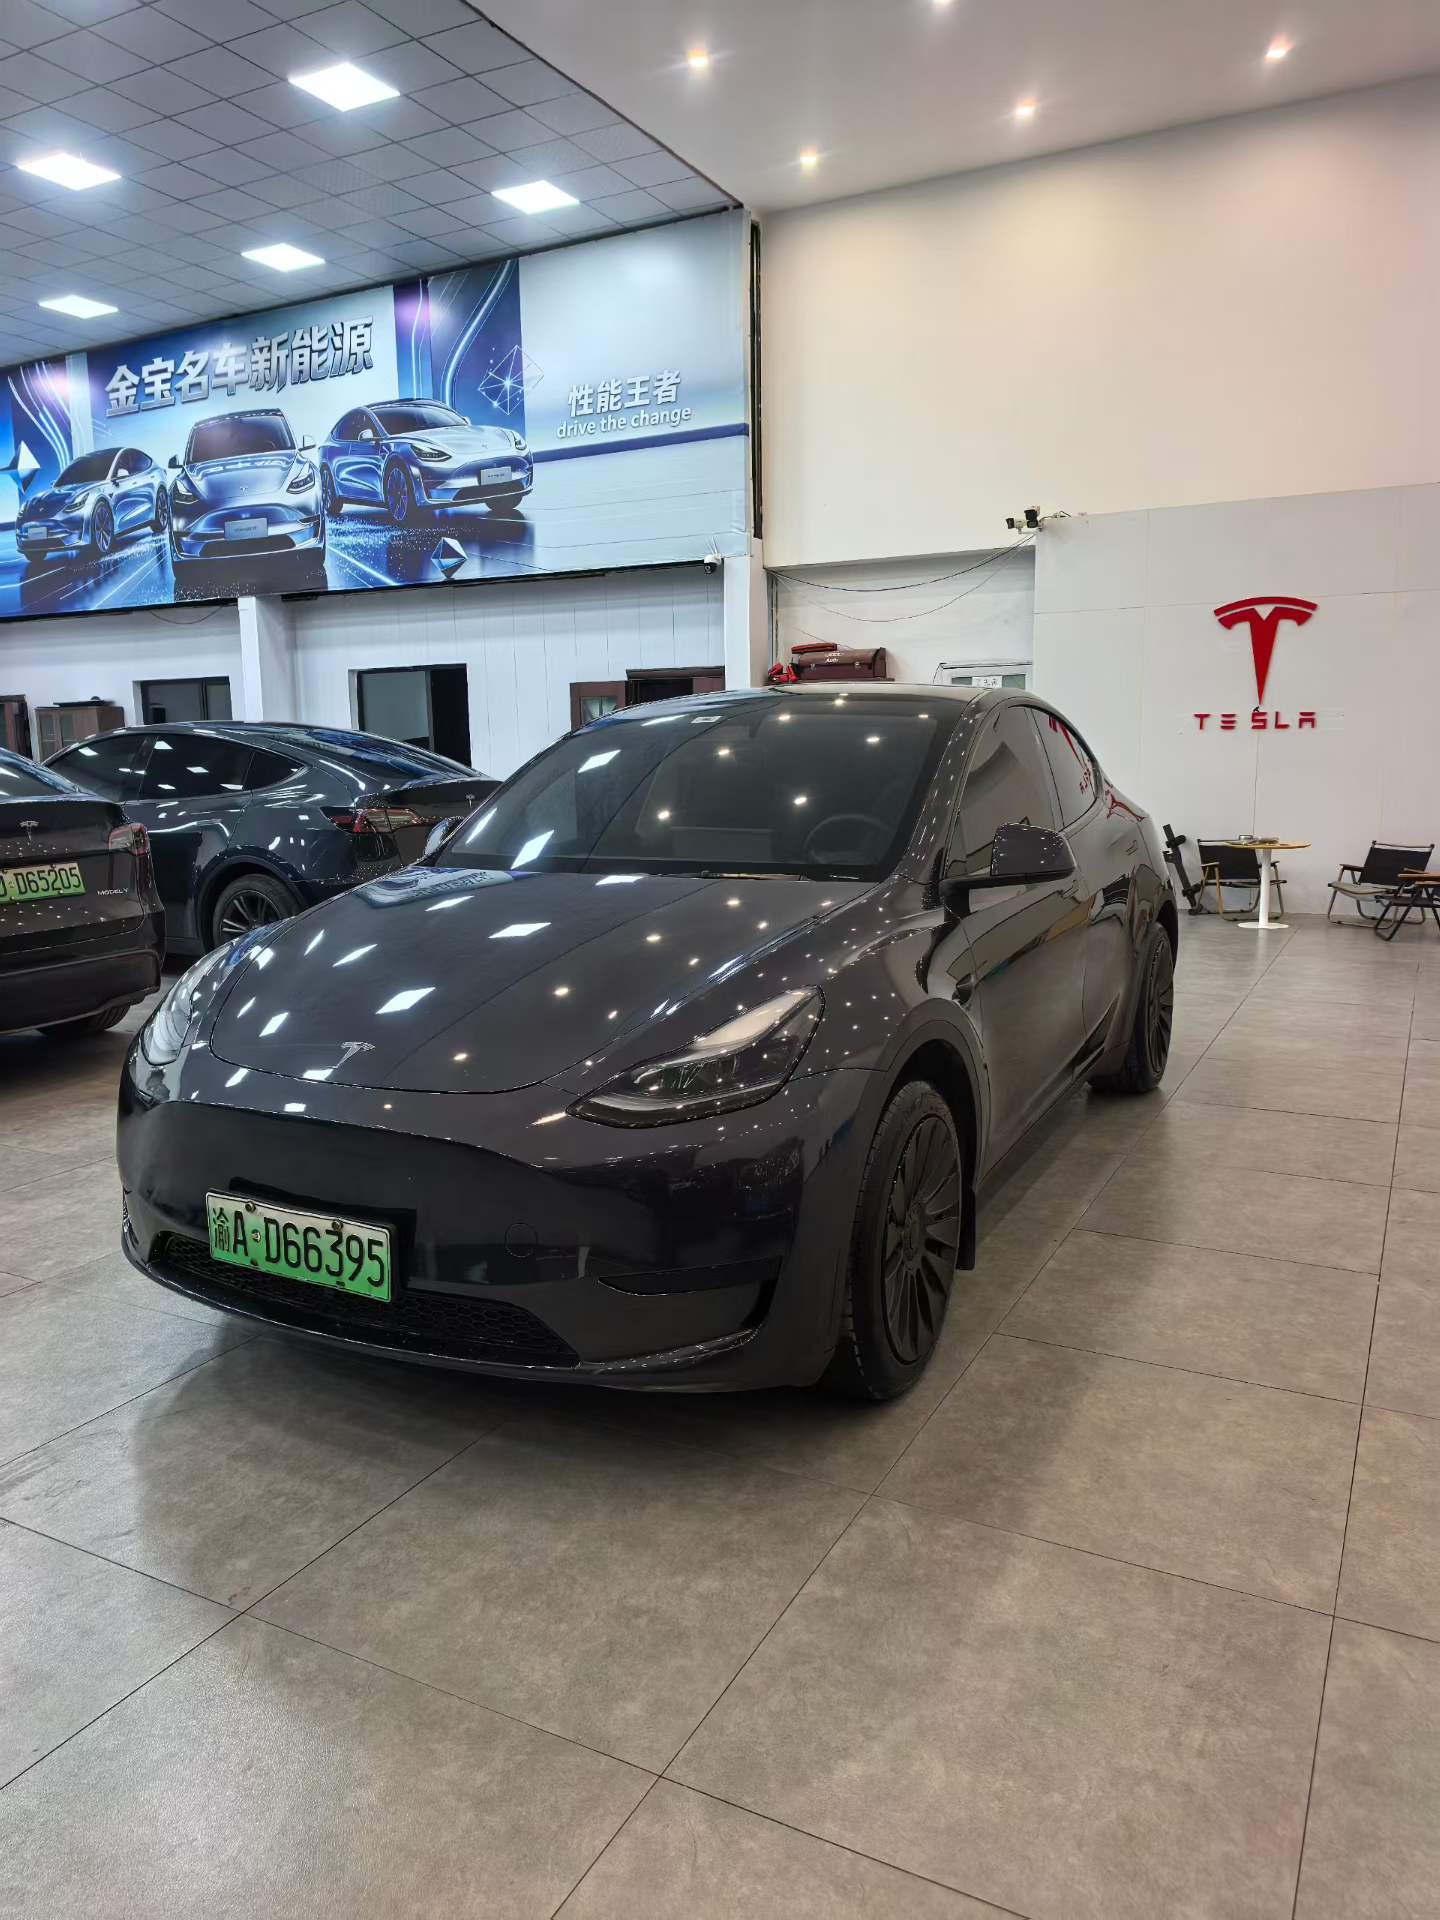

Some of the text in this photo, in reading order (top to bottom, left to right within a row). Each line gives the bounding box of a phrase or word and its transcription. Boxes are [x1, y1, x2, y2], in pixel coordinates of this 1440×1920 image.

[105, 316, 375, 418] 金宝名车新能源
[568, 369, 681, 418] 性能王者
[556, 406, 692, 439] drive the change
[1193, 711, 1317, 731] TESLA
